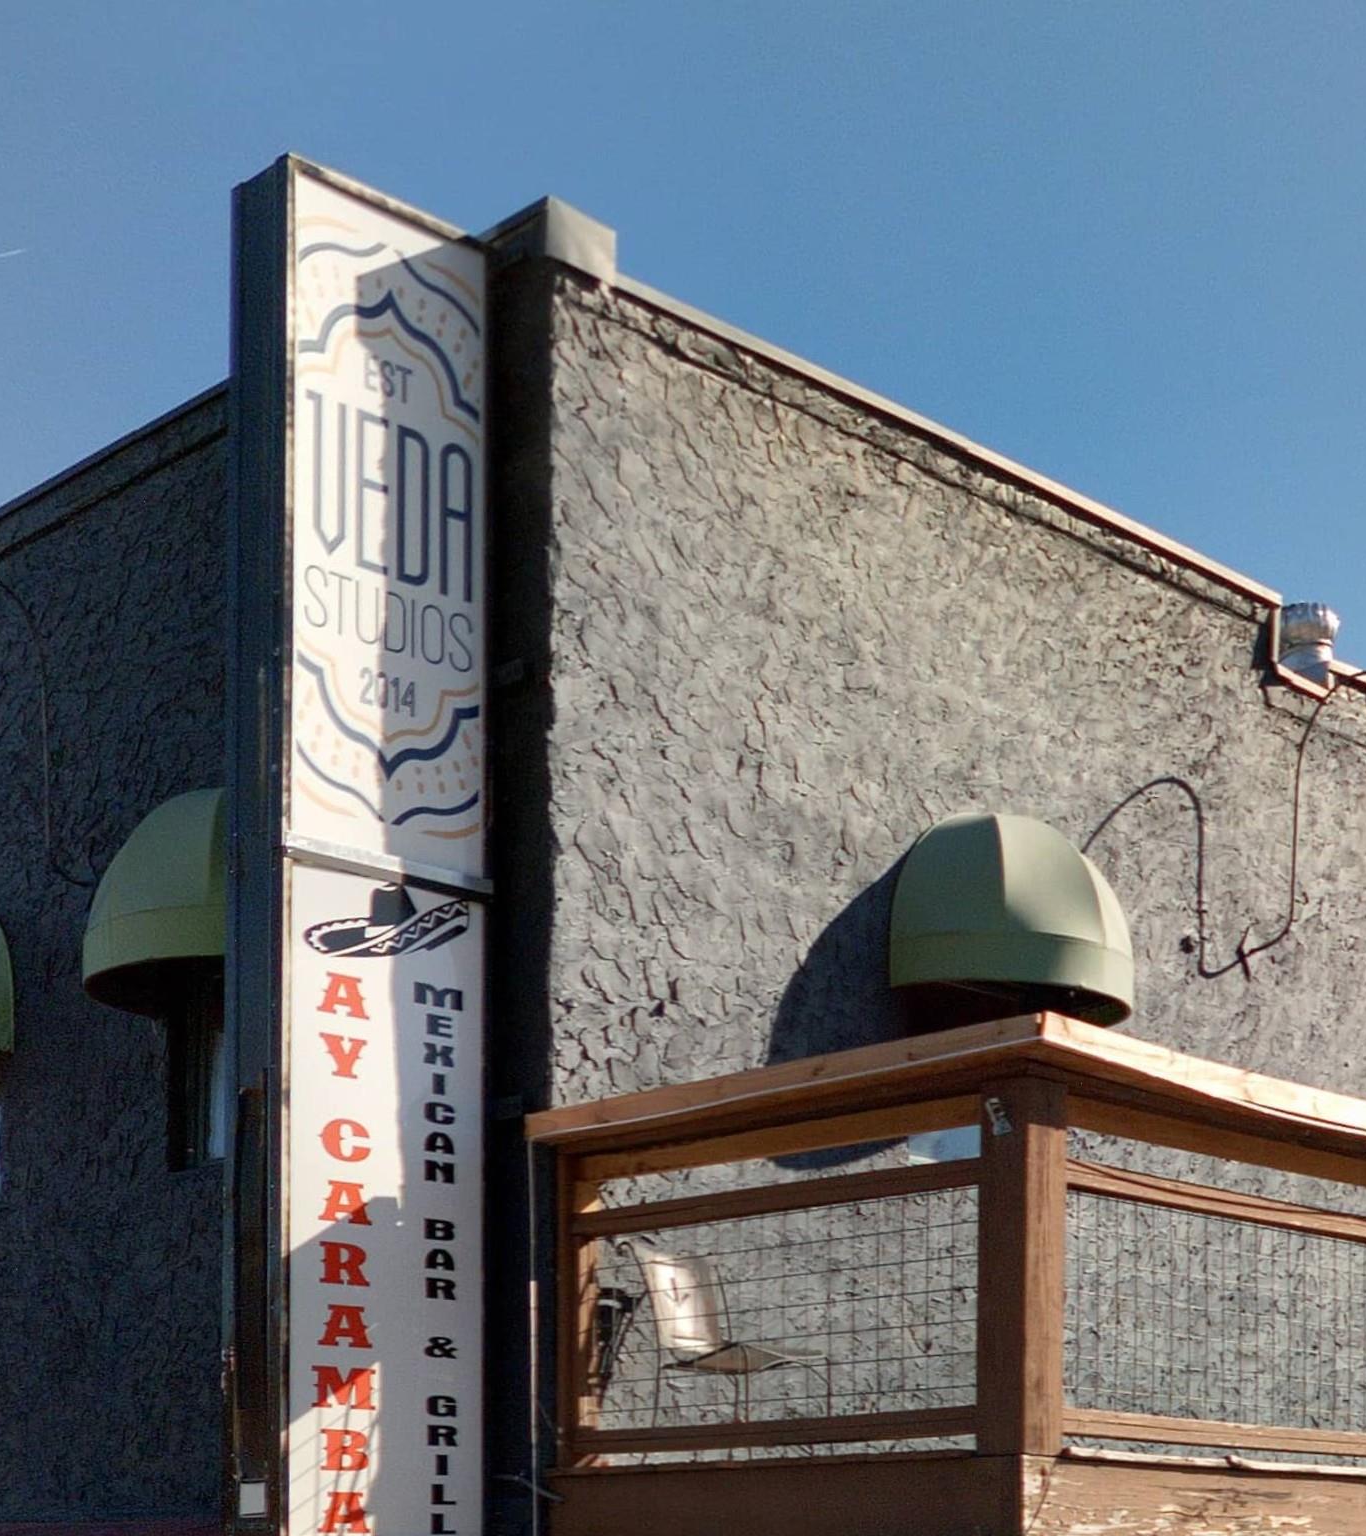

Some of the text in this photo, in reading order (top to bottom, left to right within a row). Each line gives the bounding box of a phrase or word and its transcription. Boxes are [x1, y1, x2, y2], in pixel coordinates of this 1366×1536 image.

[364, 354, 412, 406] EST
[305, 388, 474, 604] VEDA
[304, 564, 473, 672] STUDIOS
[359, 666, 417, 718] 2014
[311, 970, 376, 1535] AY CARAMBA
[413, 980, 463, 1536] MEXICAN BAR & GRILL
